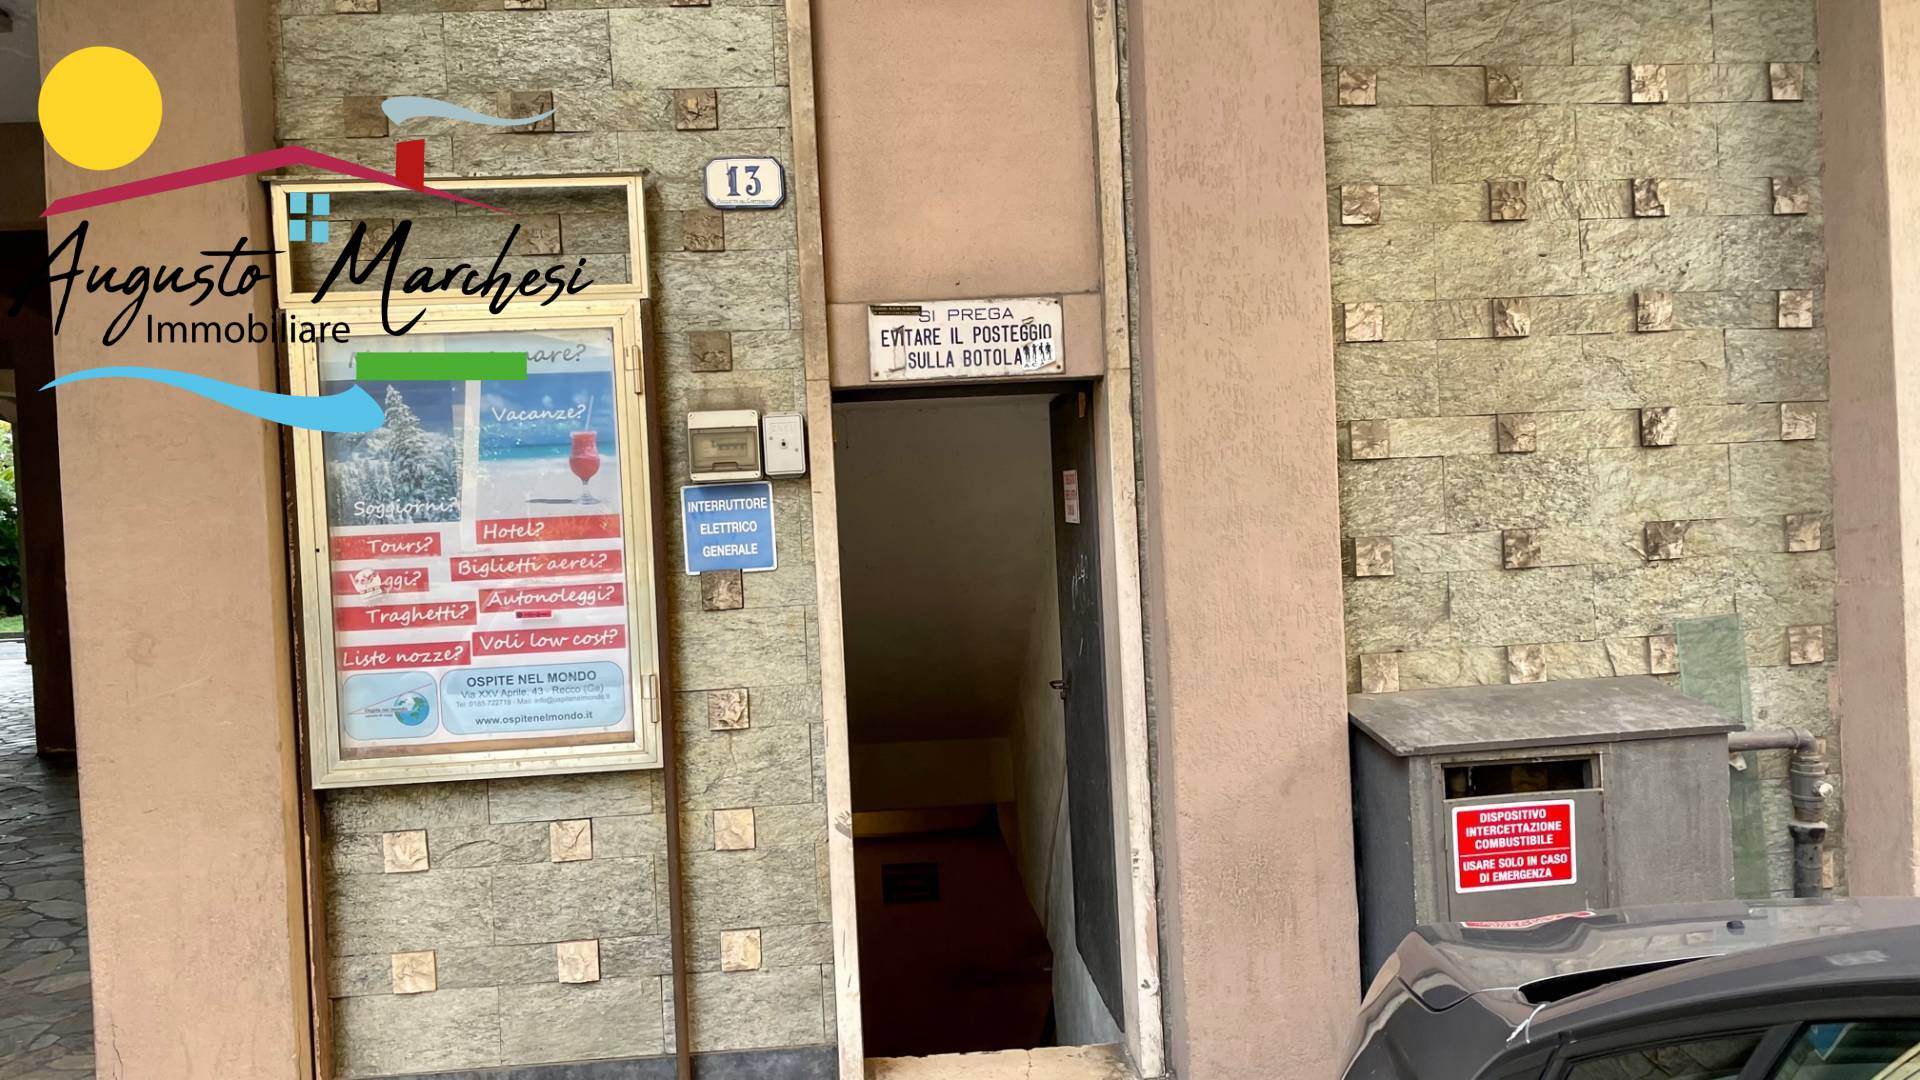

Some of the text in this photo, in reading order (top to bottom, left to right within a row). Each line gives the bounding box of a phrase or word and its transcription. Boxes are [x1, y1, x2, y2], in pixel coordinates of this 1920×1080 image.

[726, 165, 762, 196] 13
[919, 309, 935, 323] SI
[947, 307, 1014, 322] PREGA
[881, 323, 1052, 347] EVITARE IL POSTEGGIO
[908, 348, 1023, 369] SULLA BOTOLA
[491, 404, 587, 423] Vacanze?
[353, 496, 458, 520] Soggiorni?
[687, 497, 768, 513] INTERRUTTORE
[483, 521, 545, 540] Hotel?
[700, 520, 758, 535] ELETTRICO
[366, 536, 433, 554] Tours?
[702, 543, 759, 557] GENERALE
[458, 553, 608, 577] Biglietti aerei?
[349, 570, 422, 592] Vggi?
[487, 586, 615, 606] Autonoleggi?
[365, 604, 470, 626] Traghetti?
[479, 629, 618, 650] Voli low cost?
[343, 645, 464, 667] Liste nozze?
[466, 670, 597, 688] OSPITE NEL MONDO
[461, 689, 476, 699] Via
[479, 688, 498, 698] XXV
[531, 686, 544, 696] 43
[552, 685, 581, 695] Recco
[475, 711, 593, 726] www.ospitenelmondo.it
[1479, 808, 1547, 823] DISPOSITIVO
[1465, 821, 1563, 838] INTERCETTAZIONE
[1475, 834, 1554, 850] COMBUSTIBILE
[1462, 853, 1568, 871] USARE SOLO IN CASO
[1479, 867, 1553, 883] DI EMERGENZA
